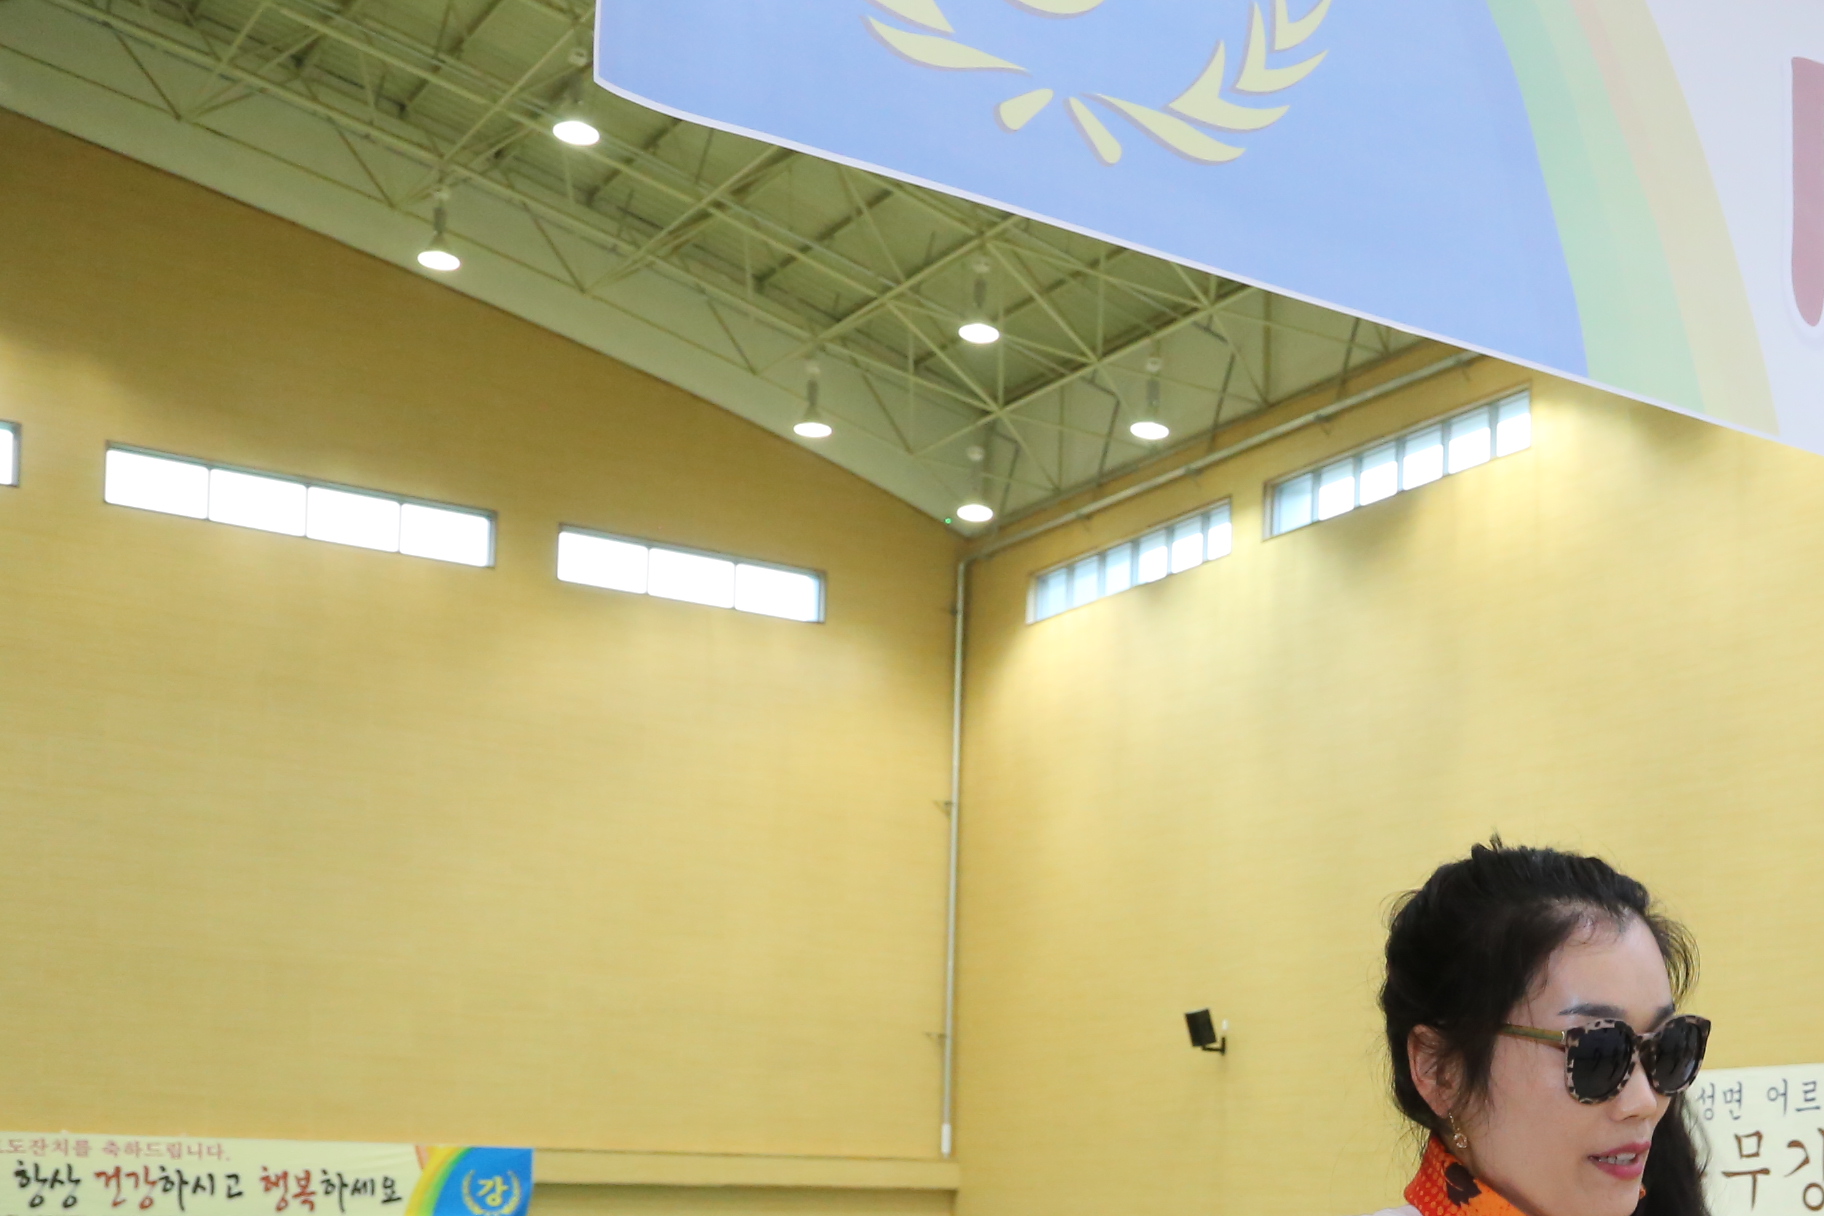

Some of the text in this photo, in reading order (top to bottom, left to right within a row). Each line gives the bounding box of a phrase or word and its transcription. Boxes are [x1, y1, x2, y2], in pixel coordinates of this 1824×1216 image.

[0, 1137, 232, 1162] 도잔치를 축하드립니다.
[13, 1159, 403, 1214] 항상 건강하시고 행복하세요
[477, 1175, 509, 1207] 강
